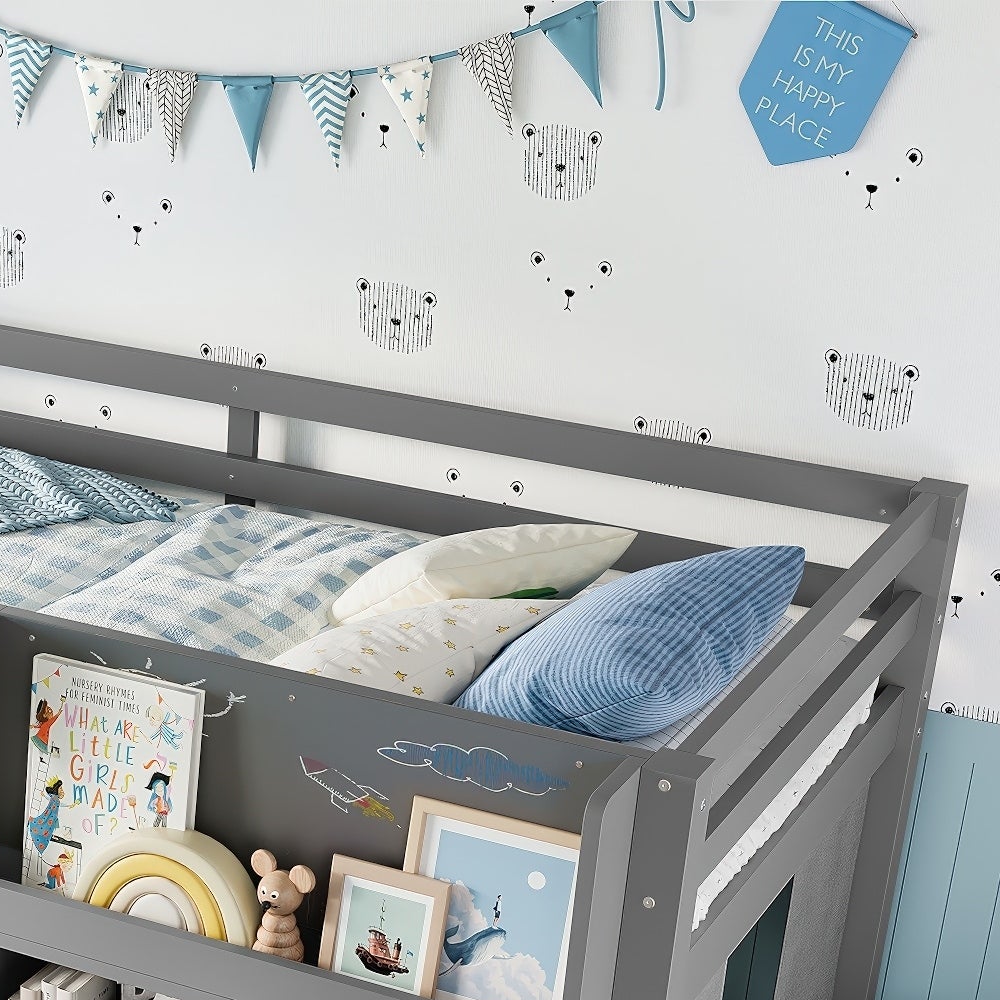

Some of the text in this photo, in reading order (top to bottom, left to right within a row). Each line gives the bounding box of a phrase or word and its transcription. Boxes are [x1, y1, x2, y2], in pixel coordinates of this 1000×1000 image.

[814, 15, 864, 56] THIS
[793, 44, 854, 85] IS MY
[772, 69, 846, 117] HAPPY
[754, 95, 832, 149] PLACE
[66, 688, 141, 714] FOR FEMINIST TIMES
[72, 677, 136, 701] NURSERY RHYMES
[114, 719, 141, 743] ARE
